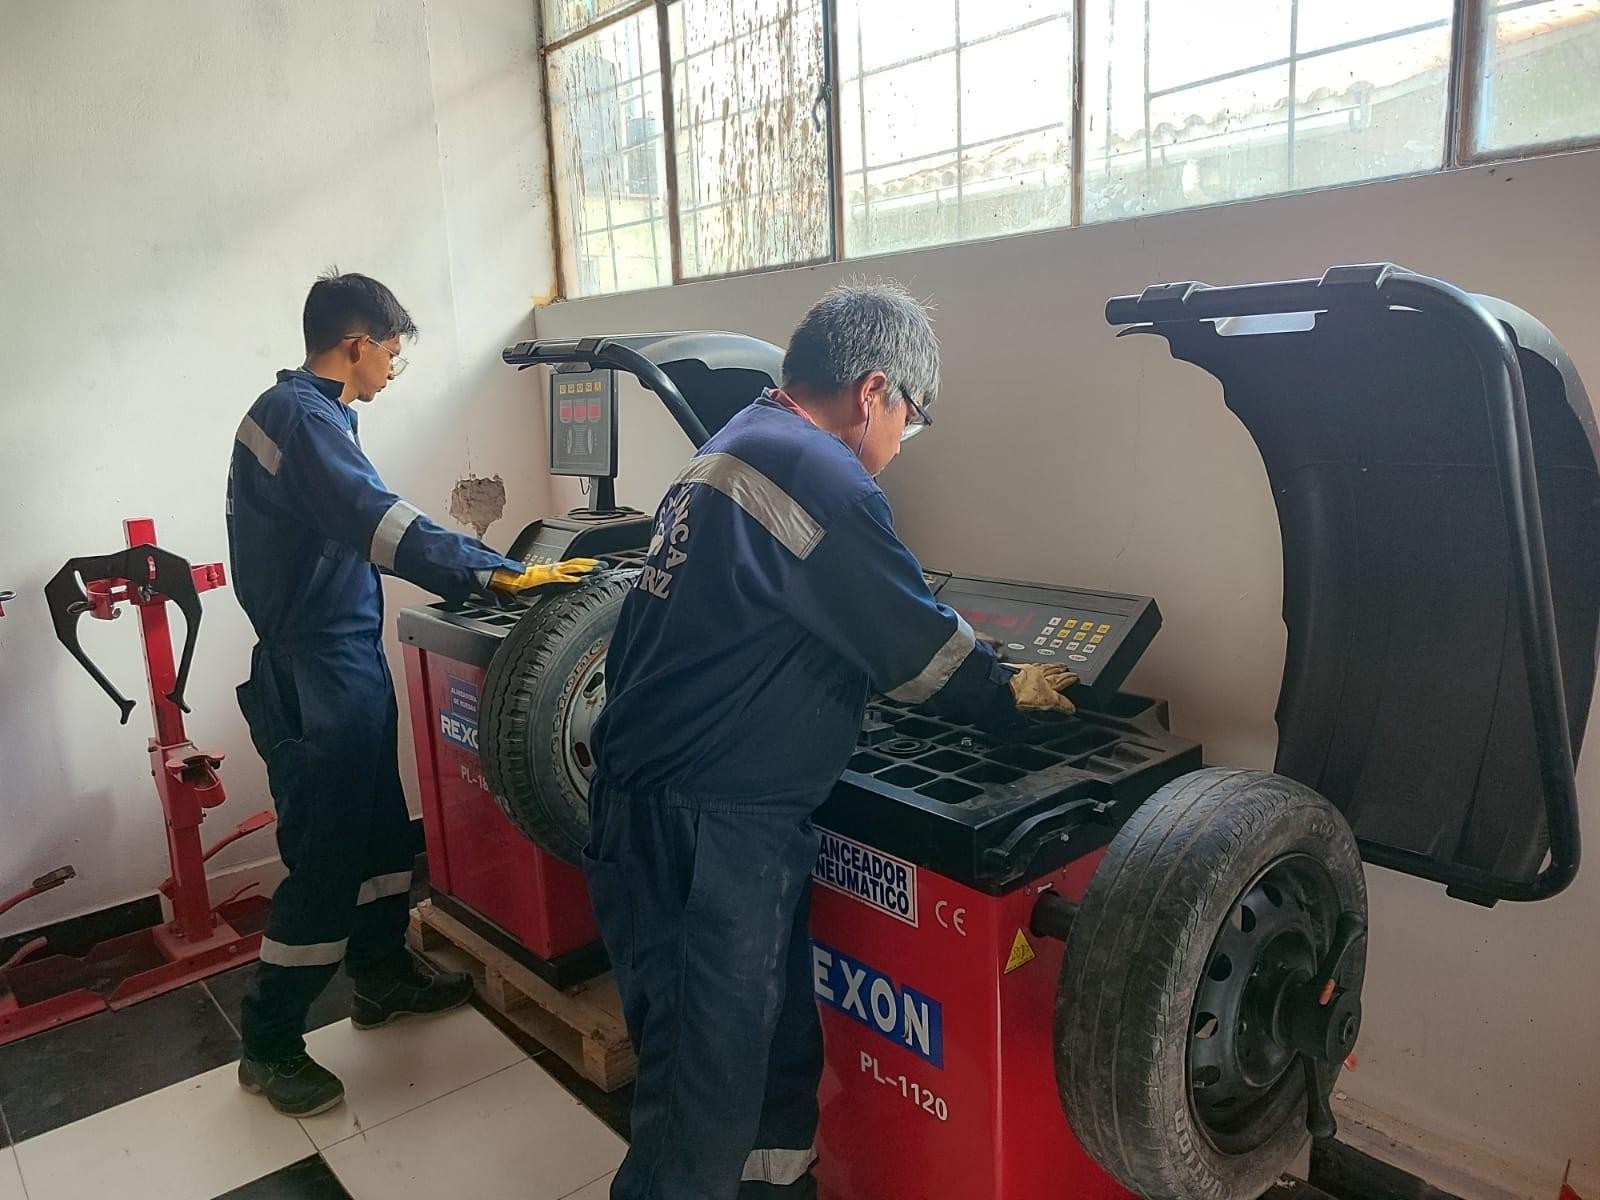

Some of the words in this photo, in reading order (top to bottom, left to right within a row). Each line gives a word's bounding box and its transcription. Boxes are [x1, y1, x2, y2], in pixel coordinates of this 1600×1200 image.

[820, 834, 908, 892] ANCEADOR
[812, 945, 931, 1057] EXON
[859, 1050, 948, 1122] PL-1120
